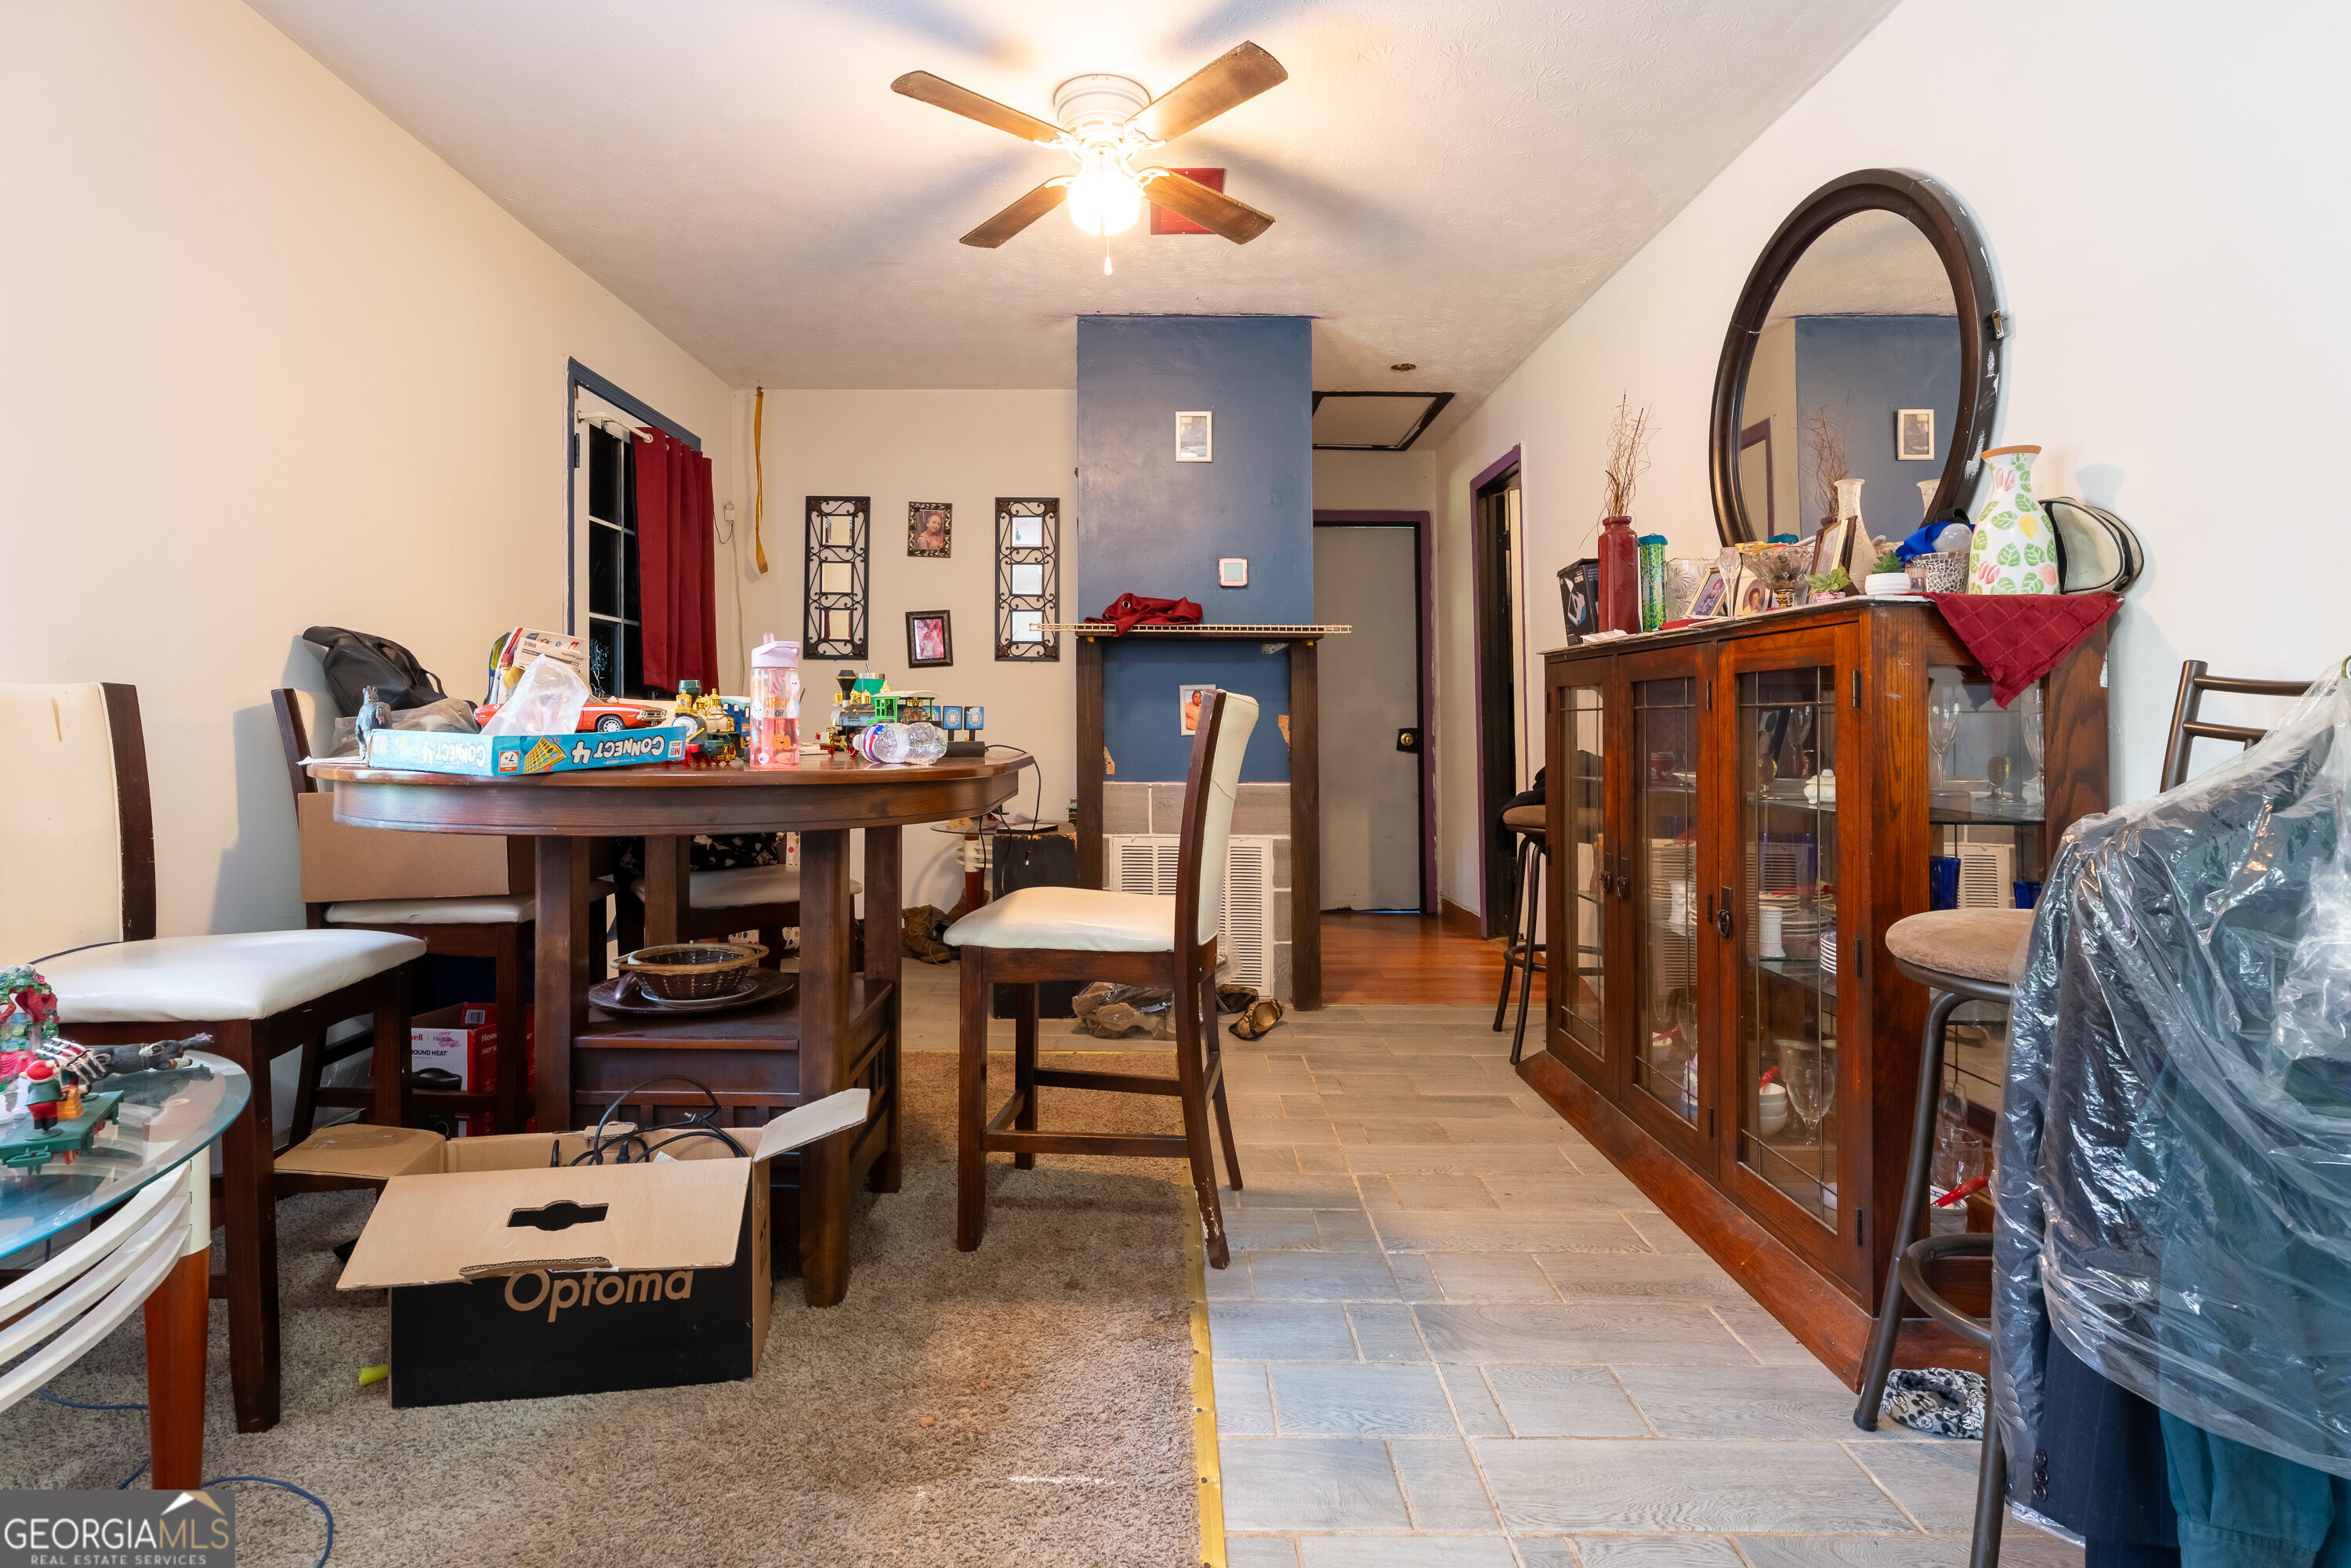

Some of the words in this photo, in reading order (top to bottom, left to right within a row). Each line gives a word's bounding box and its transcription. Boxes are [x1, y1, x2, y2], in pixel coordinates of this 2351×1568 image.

[422, 740, 433, 766] 4
[435, 741, 486, 768] CONNECT
[571, 741, 592, 765] 4
[593, 736, 665, 759] CONNECT
[670, 747, 680, 756] MB
[504, 1269, 694, 1323] Optoma
